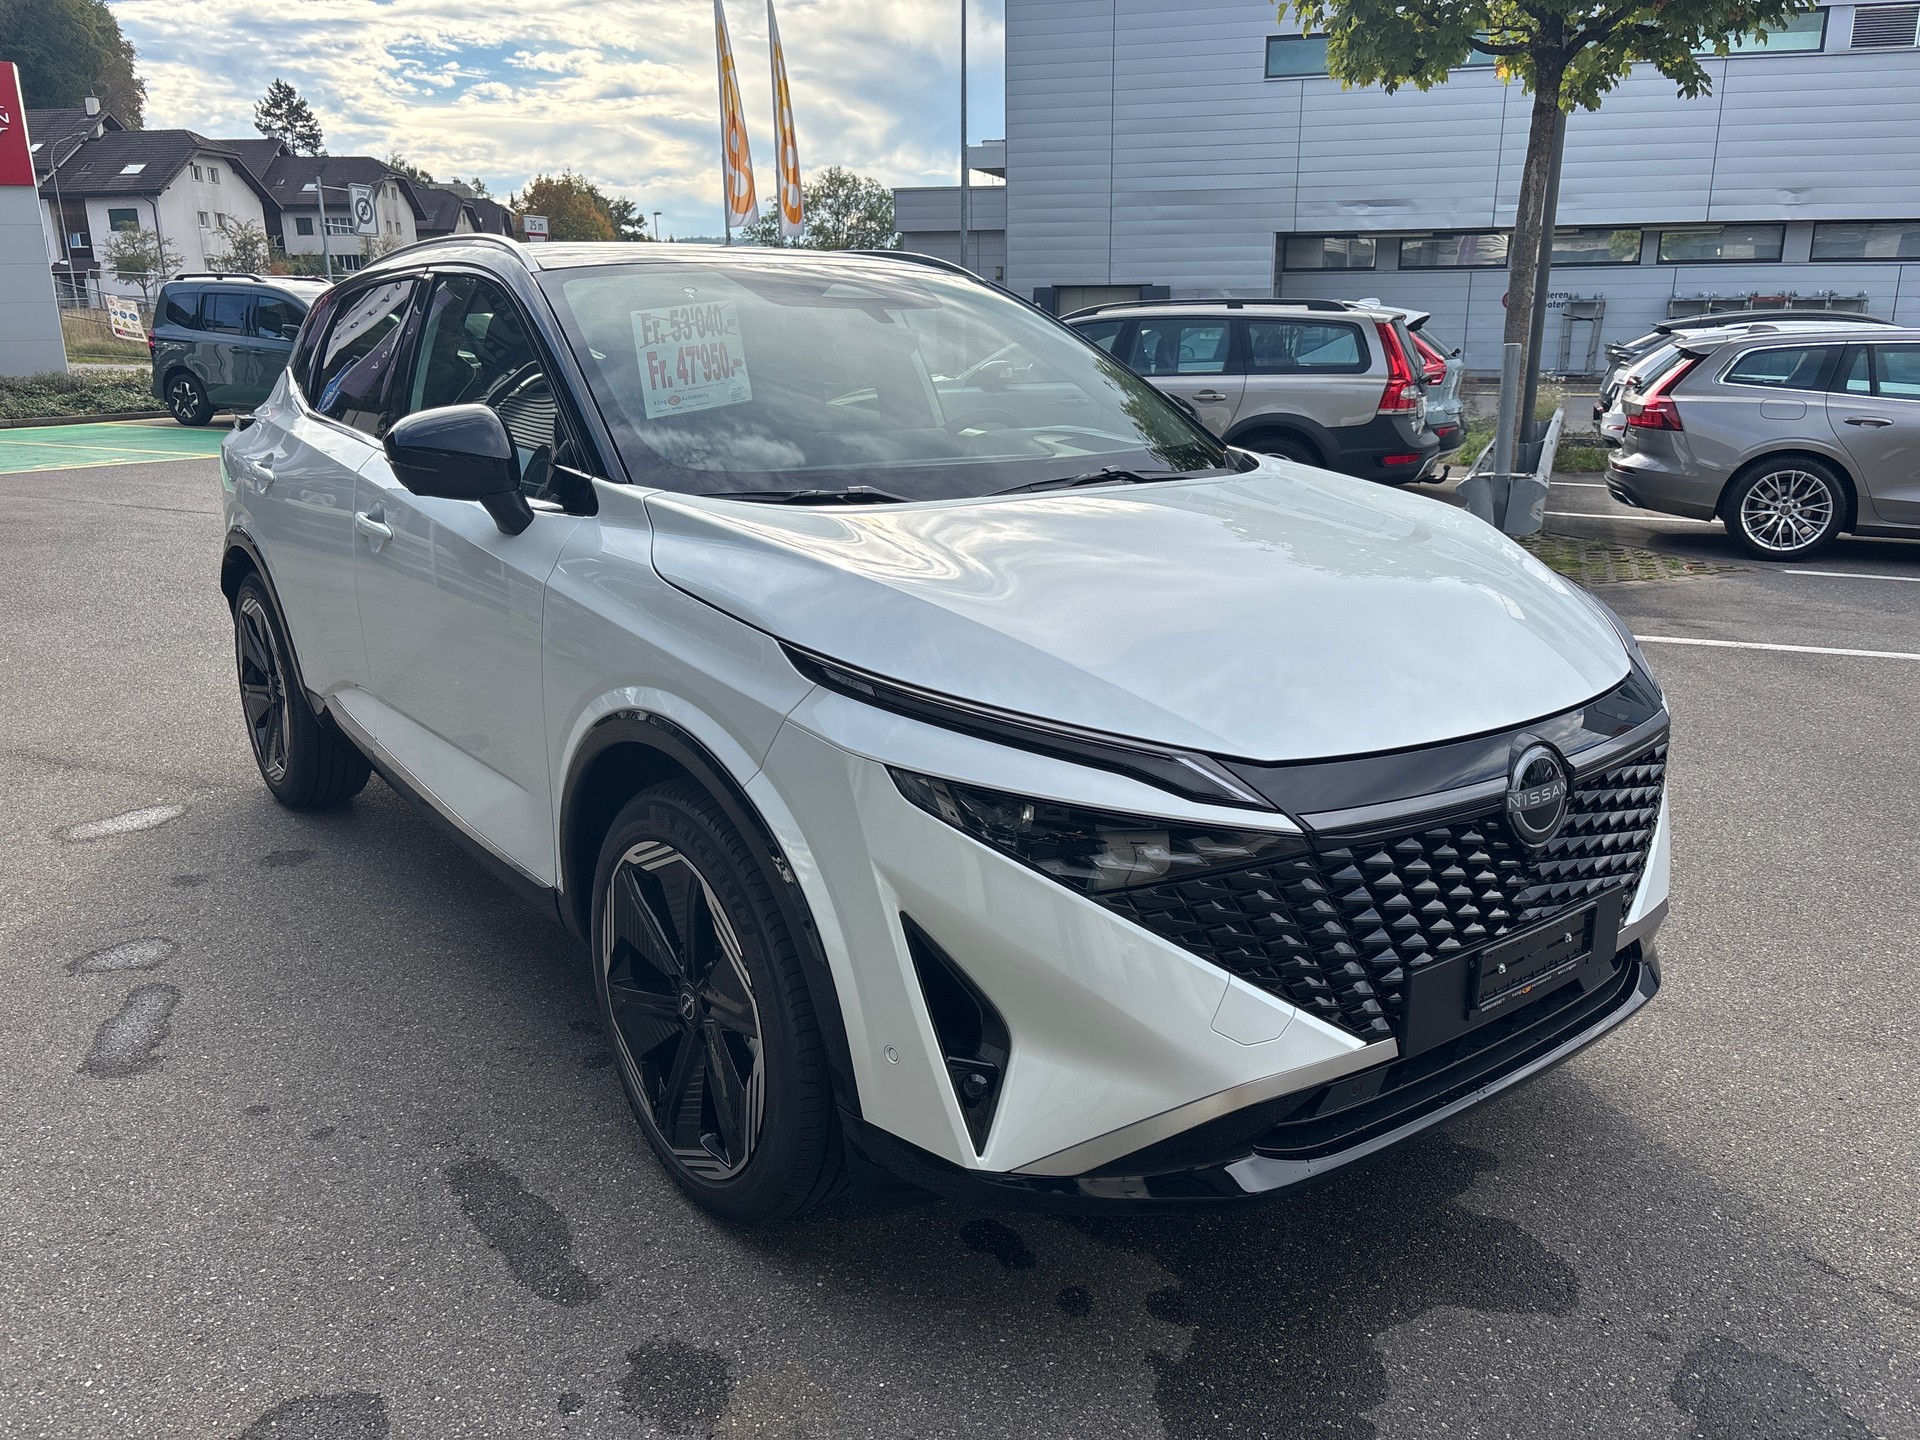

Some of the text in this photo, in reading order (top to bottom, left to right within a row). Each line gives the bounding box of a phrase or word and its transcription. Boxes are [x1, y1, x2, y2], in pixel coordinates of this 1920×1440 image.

[529, 219, 544, 231] 25 m
[640, 312, 666, 345] Fr.
[646, 351, 673, 390] Fr.
[1508, 780, 1568, 810] NISSAN
[673, 819, 750, 926] MICHELIN
